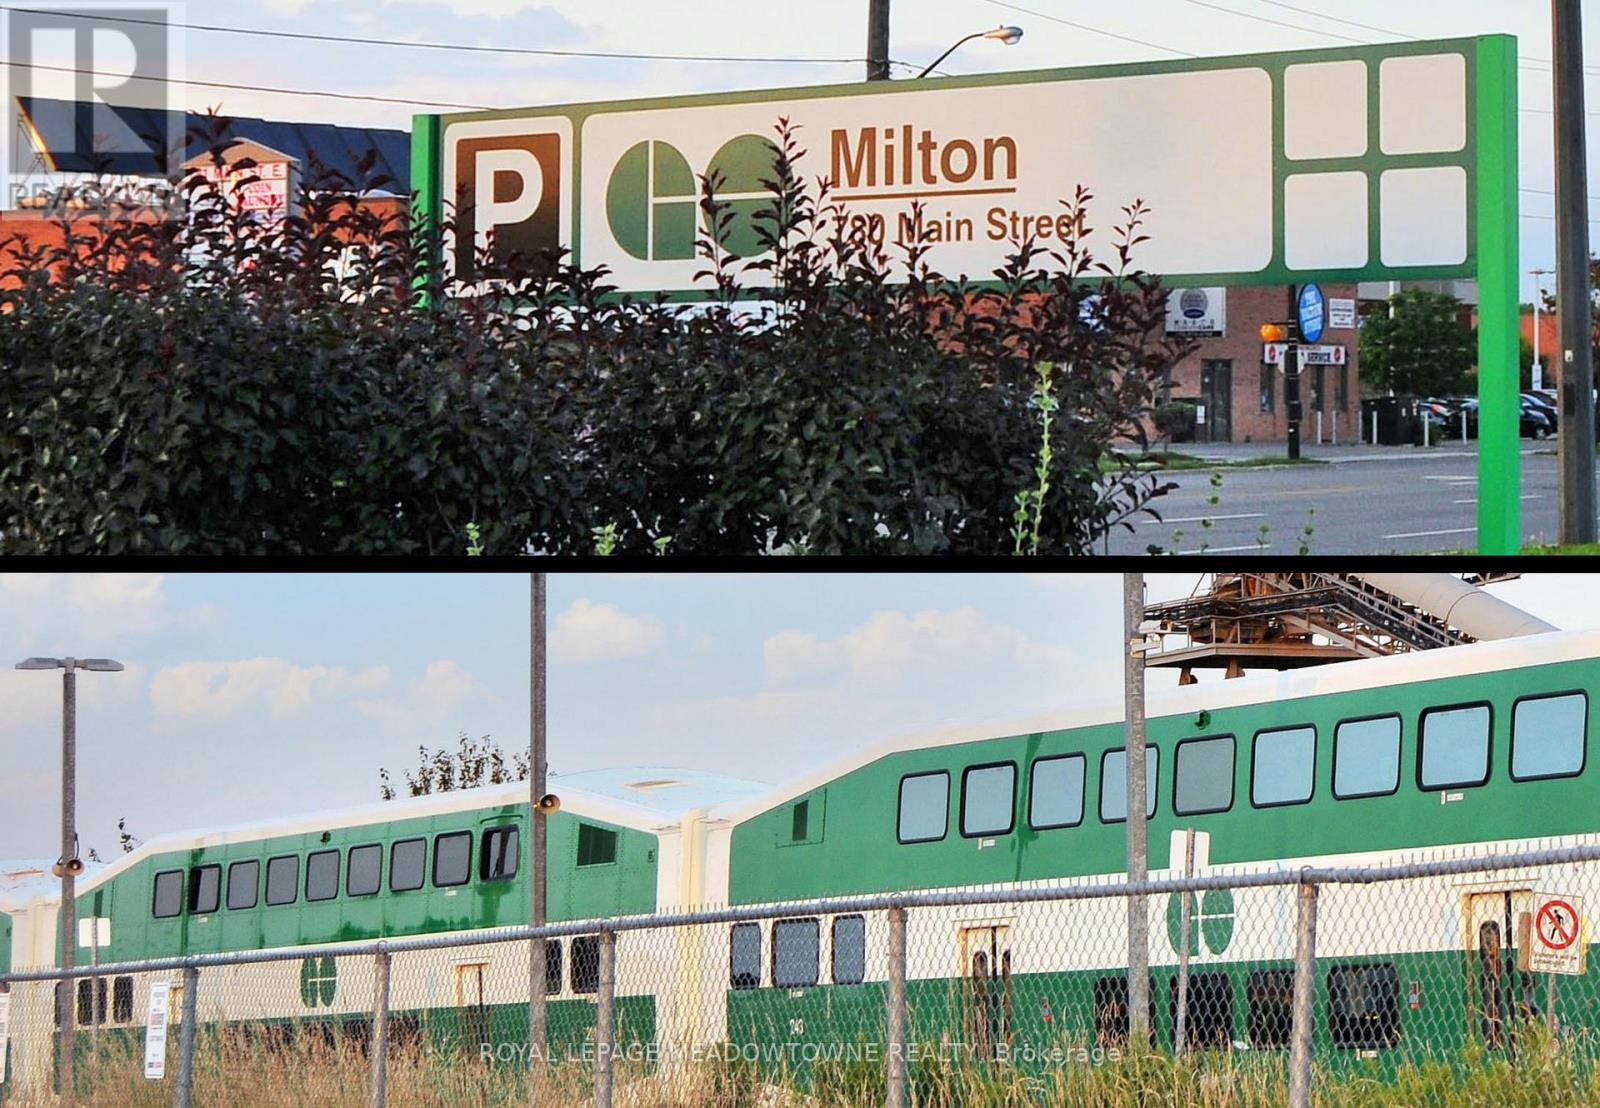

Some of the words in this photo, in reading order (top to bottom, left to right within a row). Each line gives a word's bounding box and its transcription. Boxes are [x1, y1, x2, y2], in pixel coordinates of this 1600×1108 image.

[831, 125, 1017, 188] Milton
[475, 149, 543, 278] P
[898, 211, 973, 244] Main
[987, 207, 1086, 242] Street
